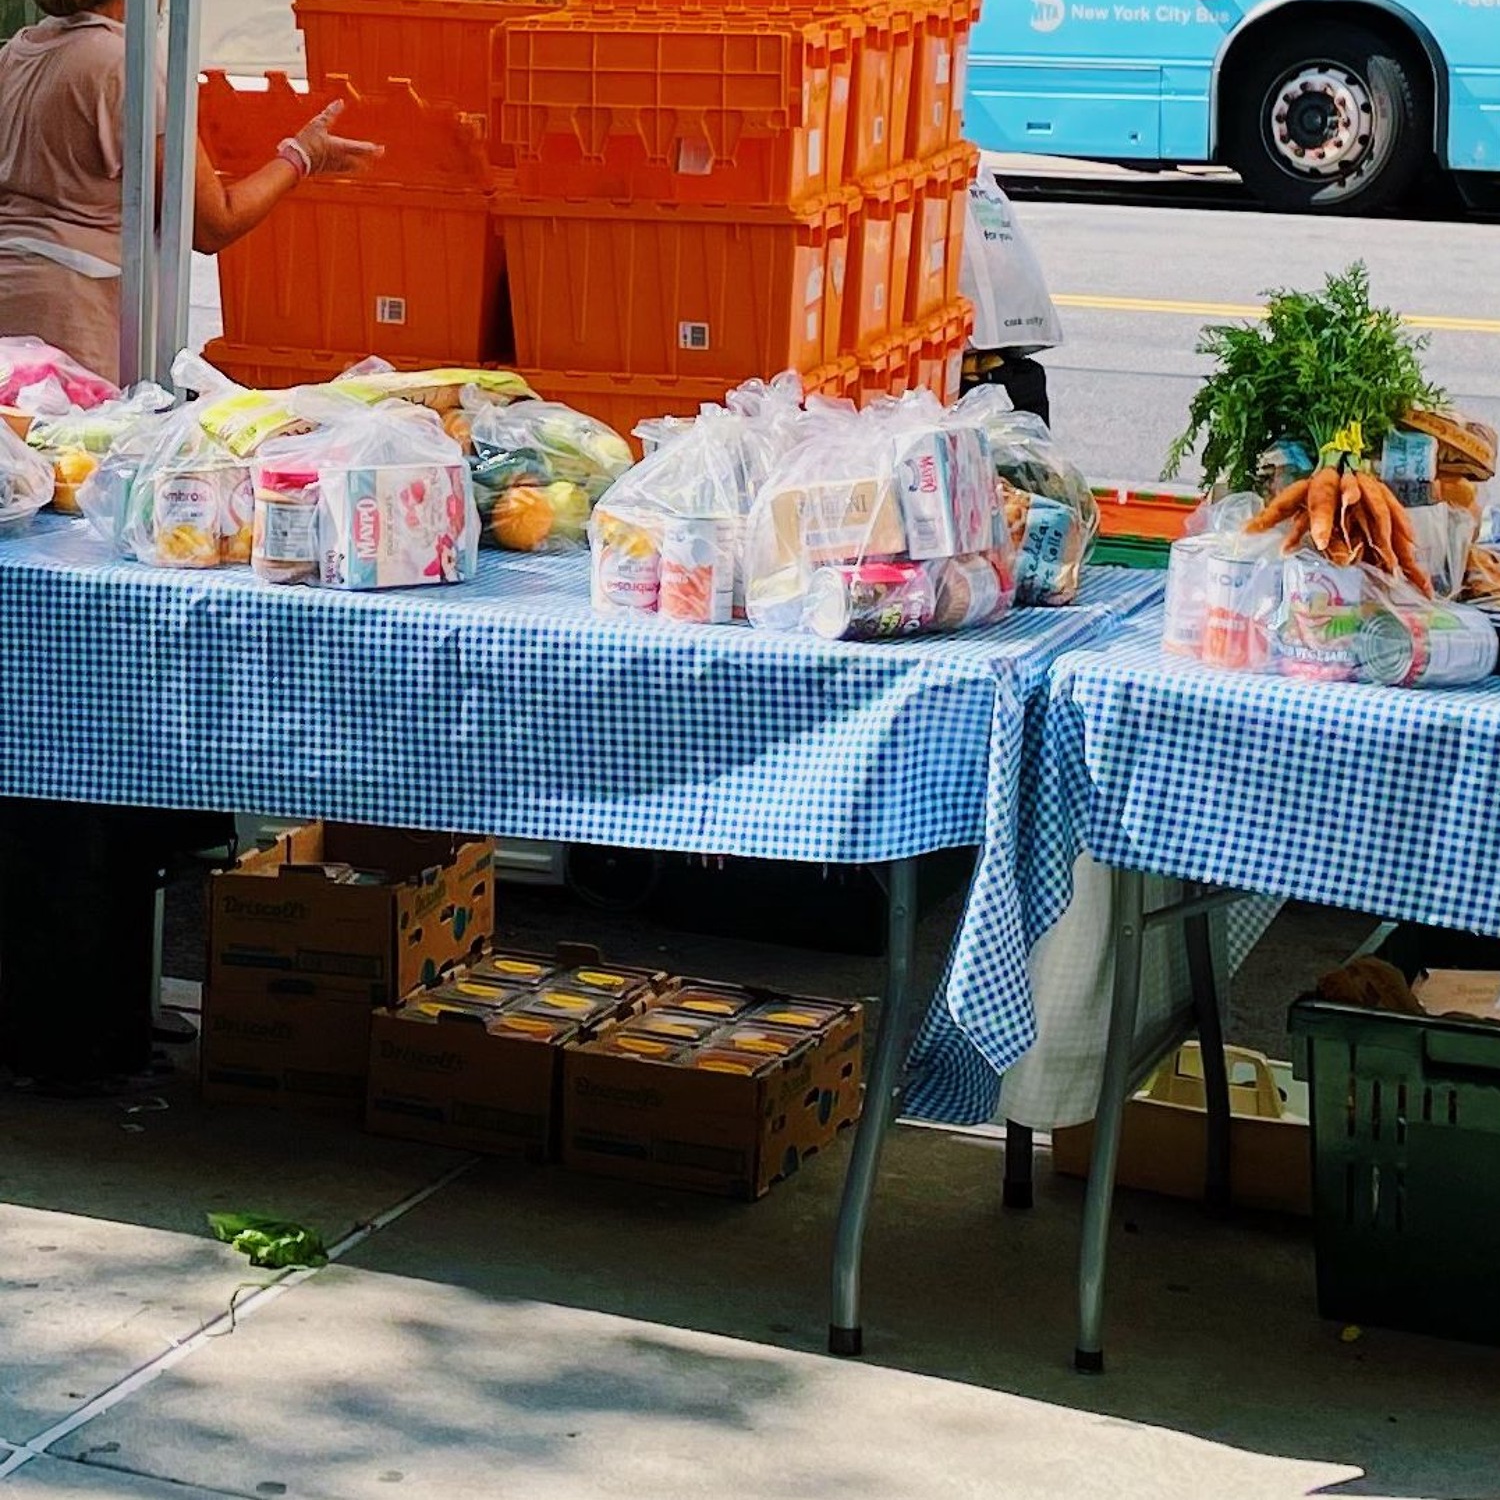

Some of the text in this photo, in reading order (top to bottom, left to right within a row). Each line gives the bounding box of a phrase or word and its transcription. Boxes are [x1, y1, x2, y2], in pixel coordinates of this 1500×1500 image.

[1071, 4, 1108, 21] New
[1113, 4, 1150, 22] York
[1155, 4, 1191, 26] City
[1196, 3, 1230, 24] Bus
[357, 500, 379, 560] MAYPO
